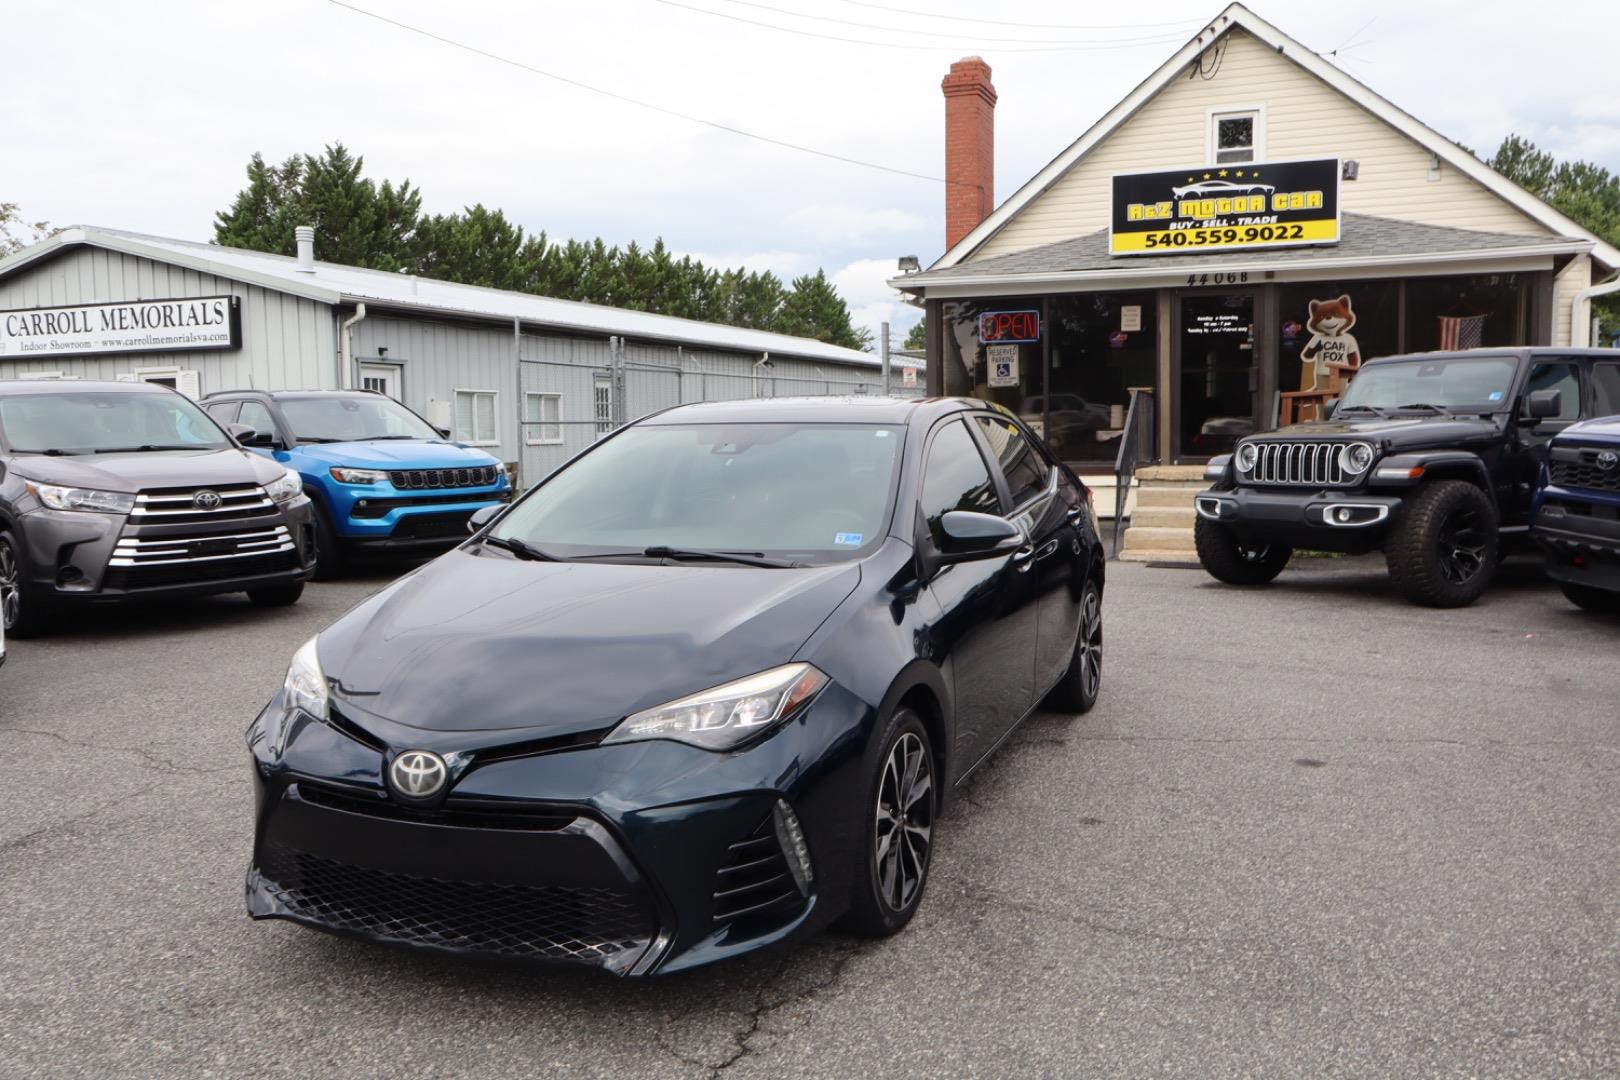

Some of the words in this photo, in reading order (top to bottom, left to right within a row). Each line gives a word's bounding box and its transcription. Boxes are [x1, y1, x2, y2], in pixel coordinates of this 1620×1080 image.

[1169, 221, 1194, 230] BUY
[1202, 219, 1229, 228] SELL
[1237, 215, 1278, 226] TRADE
[1145, 225, 1304, 248] 540.559.9022
[7, 311, 93, 337] CARROLL
[100, 301, 225, 331] MEMORIALS
[983, 313, 1037, 339] OPEN
[21, 341, 47, 351] Indoor
[50, 339, 92, 350] Showroom
[101, 332, 228, 347] www.carrollmemorialsva.com
[1323, 341, 1346, 351] CAR
[1323, 351, 1345, 362] FOX
